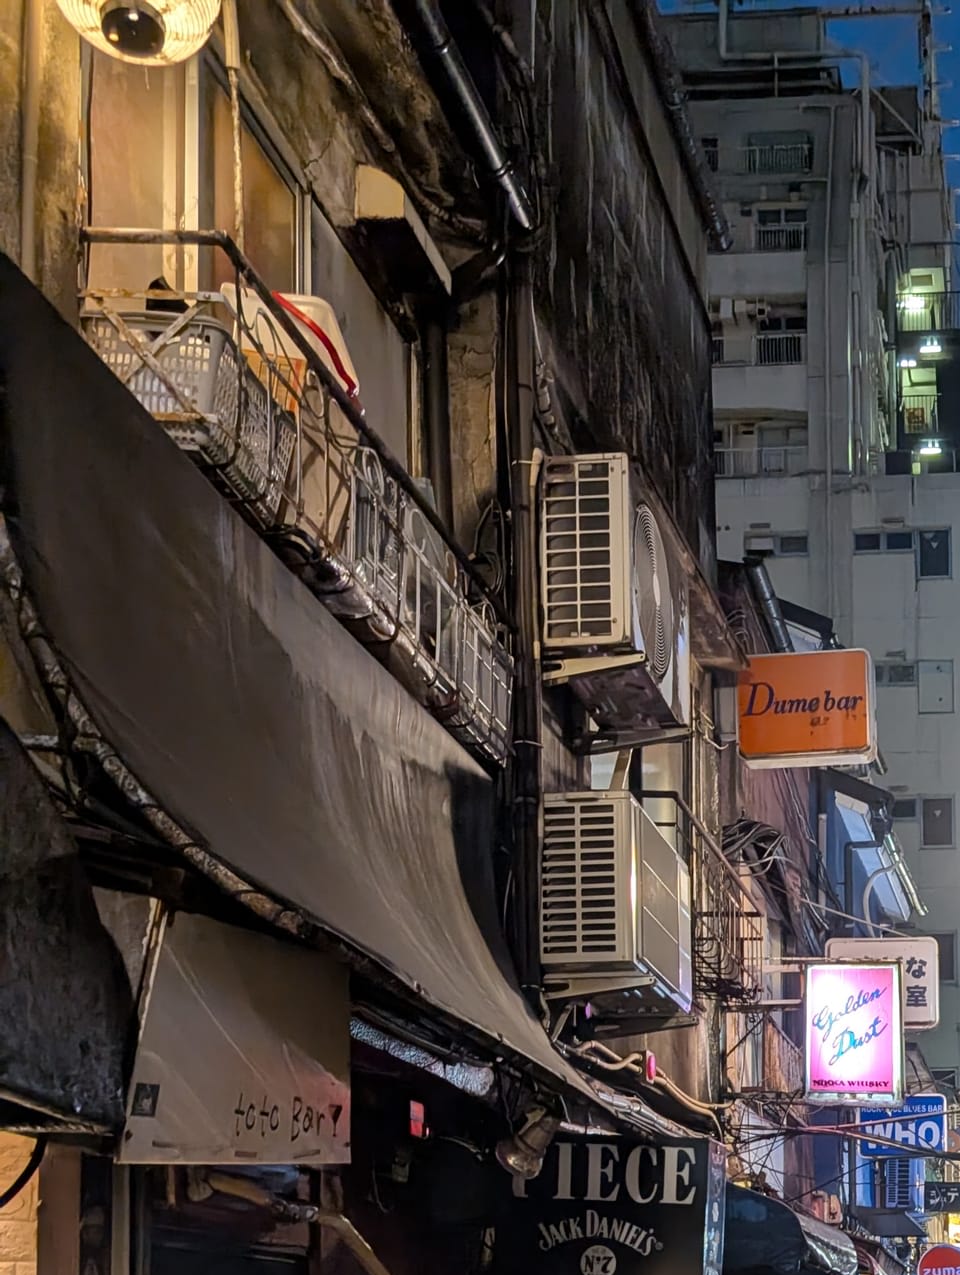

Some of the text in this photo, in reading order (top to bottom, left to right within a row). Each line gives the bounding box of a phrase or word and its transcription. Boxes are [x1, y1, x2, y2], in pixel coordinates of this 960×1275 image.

[742, 681, 864, 717] Dume bar
[811, 986, 888, 1043] Golden
[828, 1015, 889, 1066] Dust
[234, 1092, 326, 1142] toto Bar
[865, 1121, 941, 1149] WHO
[537, 1209, 658, 1257] JACK DANIEL'S
